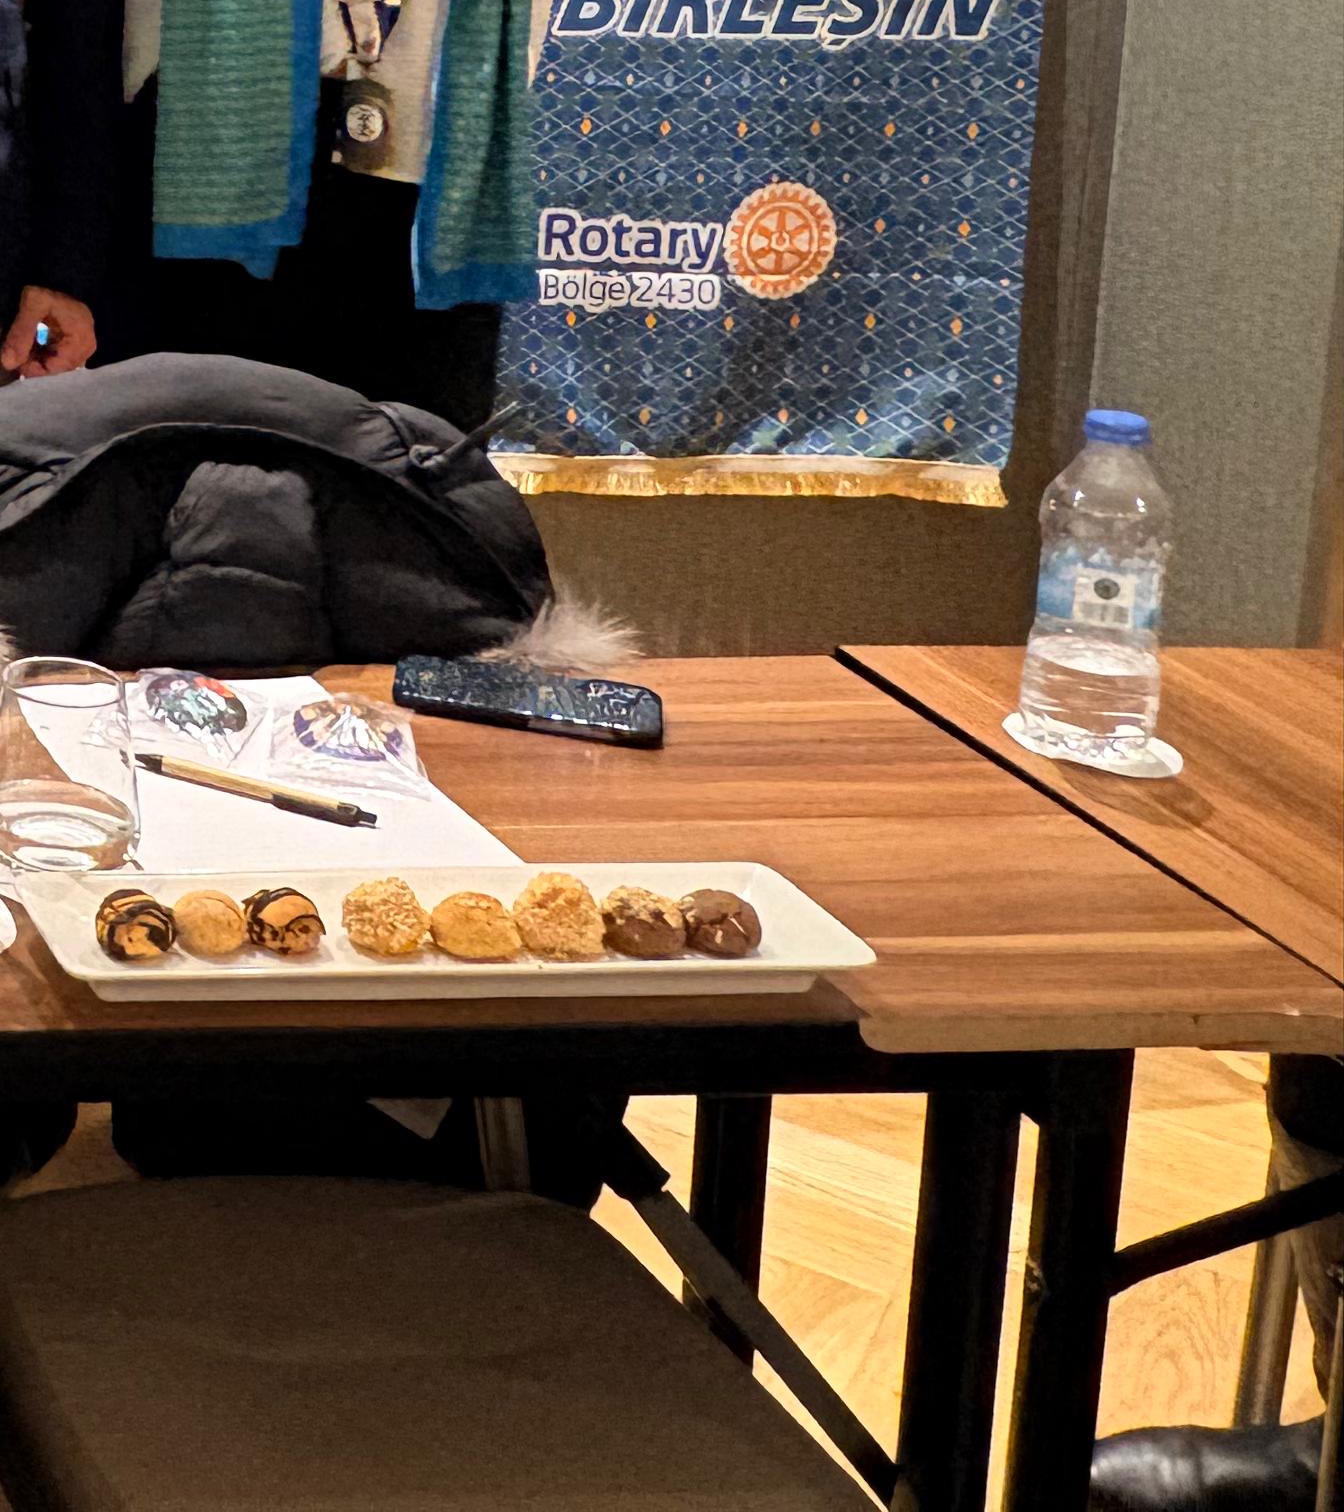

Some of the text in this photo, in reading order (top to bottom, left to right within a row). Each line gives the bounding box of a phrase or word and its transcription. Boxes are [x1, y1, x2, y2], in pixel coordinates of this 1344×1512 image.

[541, 210, 720, 271] Rotary
[542, 273, 717, 308] Bölge 2430
